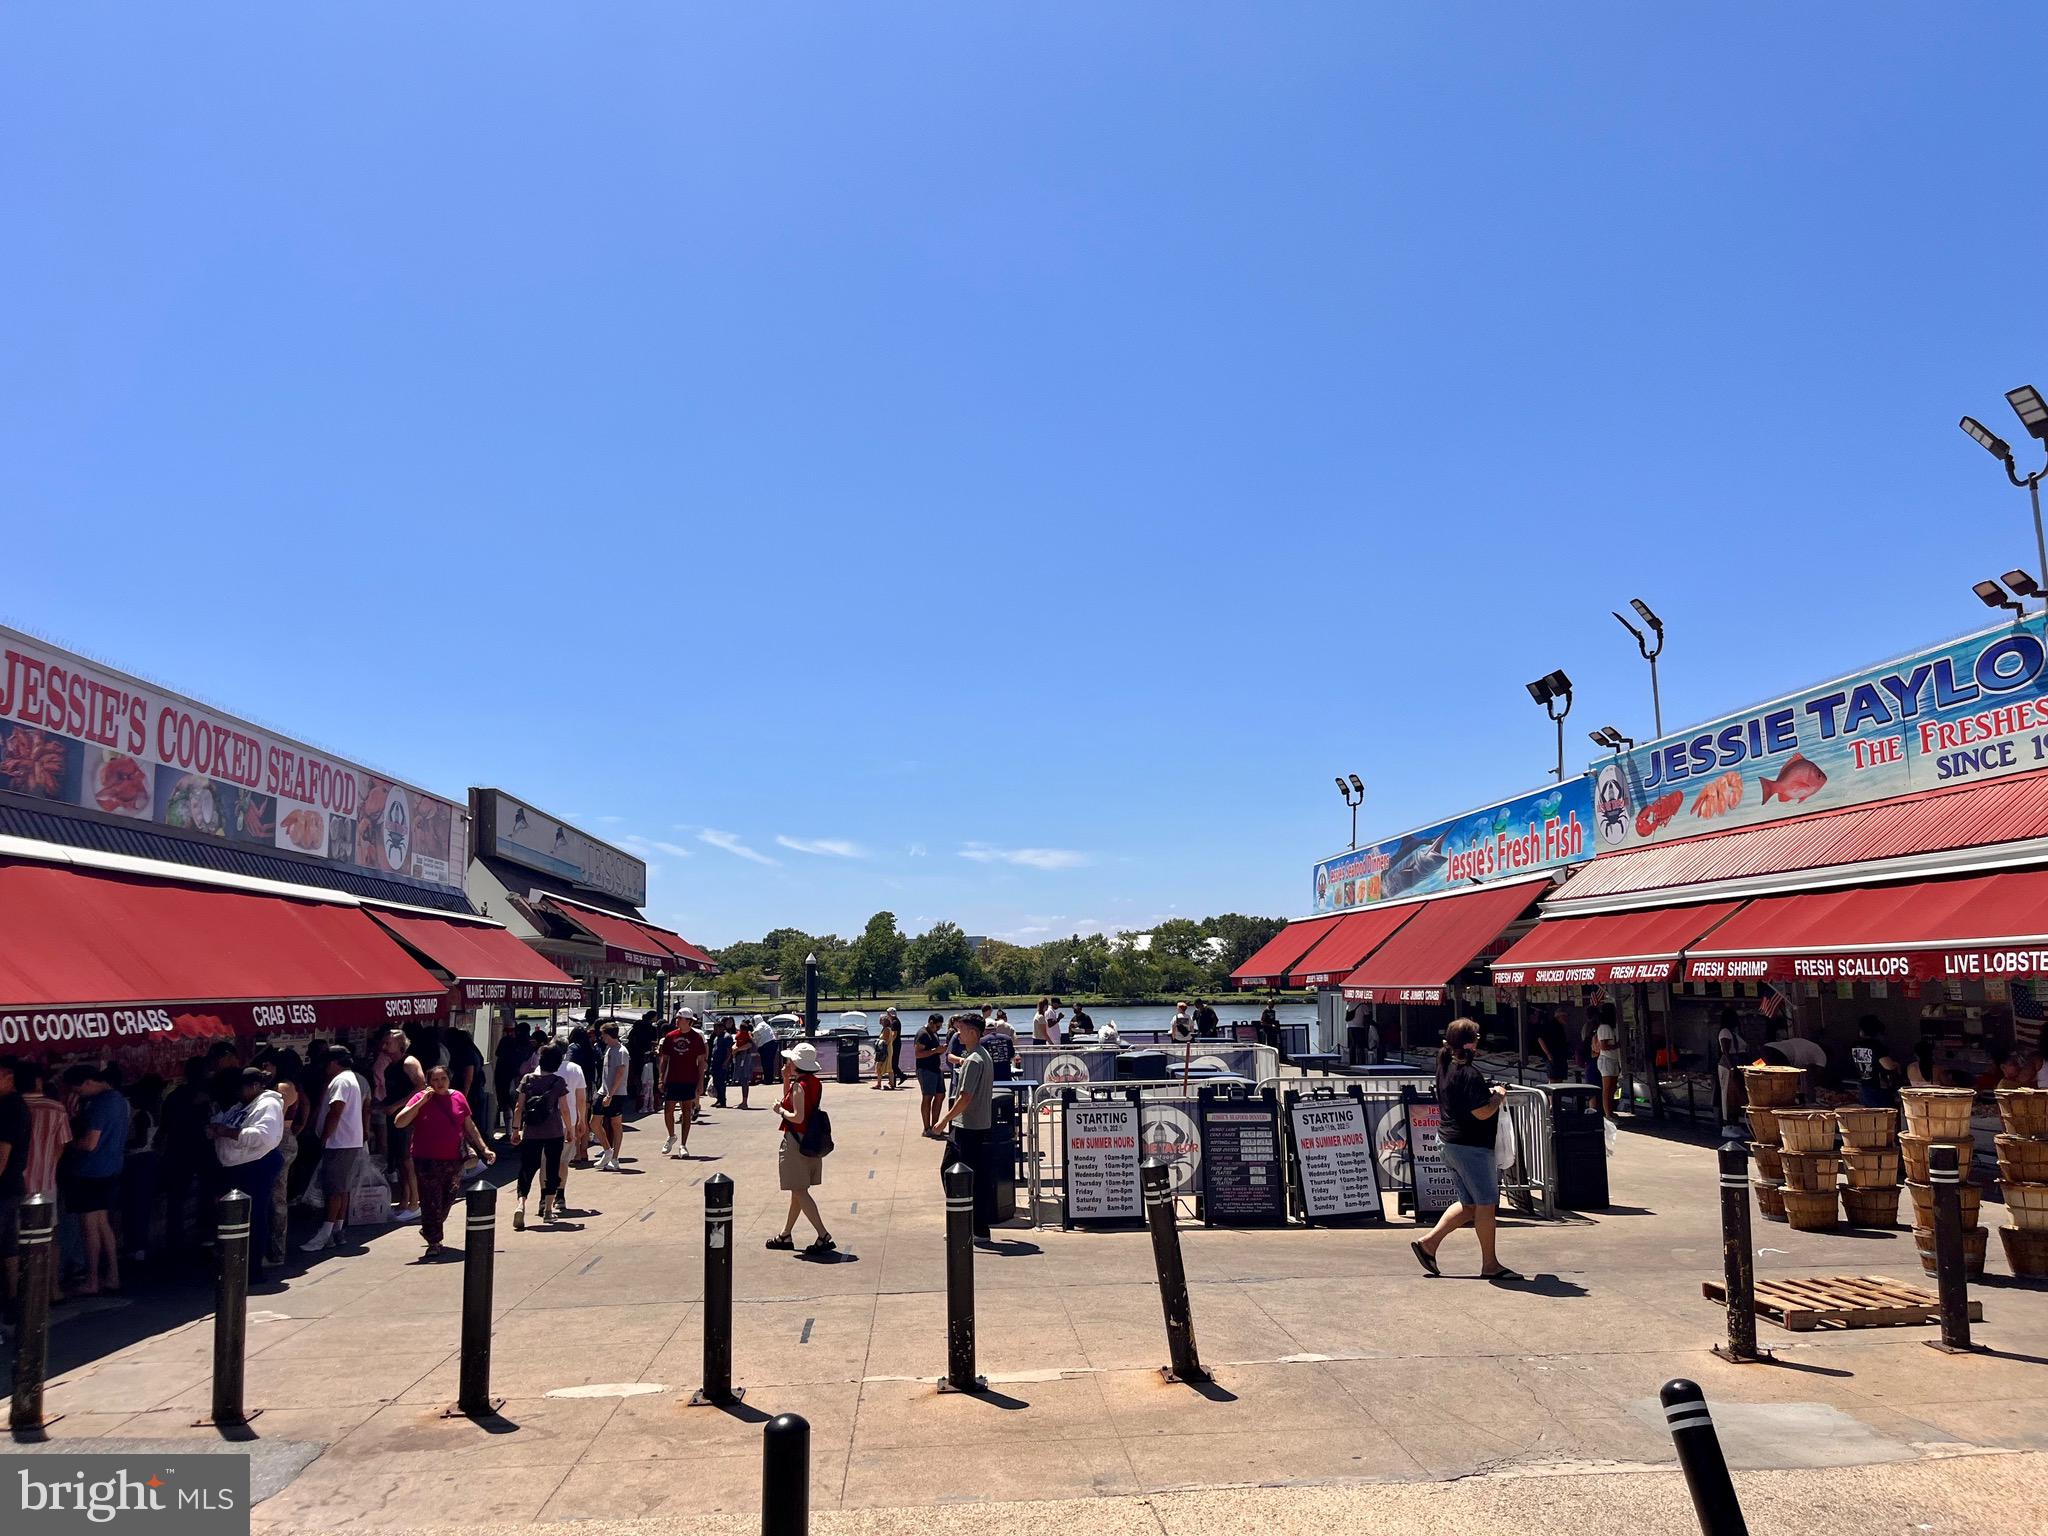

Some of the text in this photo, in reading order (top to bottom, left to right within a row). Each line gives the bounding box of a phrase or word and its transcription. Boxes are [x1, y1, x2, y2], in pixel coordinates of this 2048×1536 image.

[1643, 633, 2048, 789] JESSIE TAYLO
[0, 650, 357, 816] JESSIE'S COOKED SEAFOOD
[1848, 736, 1904, 770] THE
[1936, 741, 2017, 780] SINCE
[1446, 810, 1583, 883] Jessie's Fresh Fish
[1692, 961, 1768, 977] FRESH SHRIMP
[1794, 957, 1909, 976] FRESH SCALLOPS
[1945, 954, 1979, 974] LIVE
[1494, 971, 1525, 983] FRESH FISH
[1535, 968, 1595, 982] SHUCKED OYSTERS
[1609, 964, 1669, 979] FRESH FILLETS
[466, 984, 506, 999] MAINE LOBSTER
[1410, 990, 1424, 1000] JUMBO
[1424, 990, 1440, 1000] CRABS
[385, 998, 438, 1017] SPICED SHRIMP
[252, 1004, 317, 1027] CRAB LEGS
[0, 1009, 174, 1045] OT COOKED CRABS
[1076, 1112, 1128, 1125] STARTING
[1302, 1110, 1354, 1125] STARTING
[1413, 1118, 1440, 1127] Seafoo
[1310, 1124, 1324, 1132] March
[1071, 1138, 1085, 1149] NEW
[1086, 1137, 1112, 1149] SUMMER
[1113, 1136, 1135, 1148] HOURS
[1301, 1132, 1364, 1150] NEW SUMMER HOURS
[1161, 1143, 1199, 1153] TAYLOR
[1337, 1159, 1366, 1167] 10am-8pm
[1338, 1167, 1367, 1175] 10am-8pm
[1423, 1166, 1448, 1174] Thurs
[1339, 1175, 1369, 1183] 10am-8pm
[1429, 1177, 1454, 1185] Friday
[1313, 1194, 1339, 1202] Saturday
[1426, 1188, 1458, 1196] Saturd
[1314, 1203, 1336, 1211] Sunday
[1431, 1199, 1455, 1207] Sund
